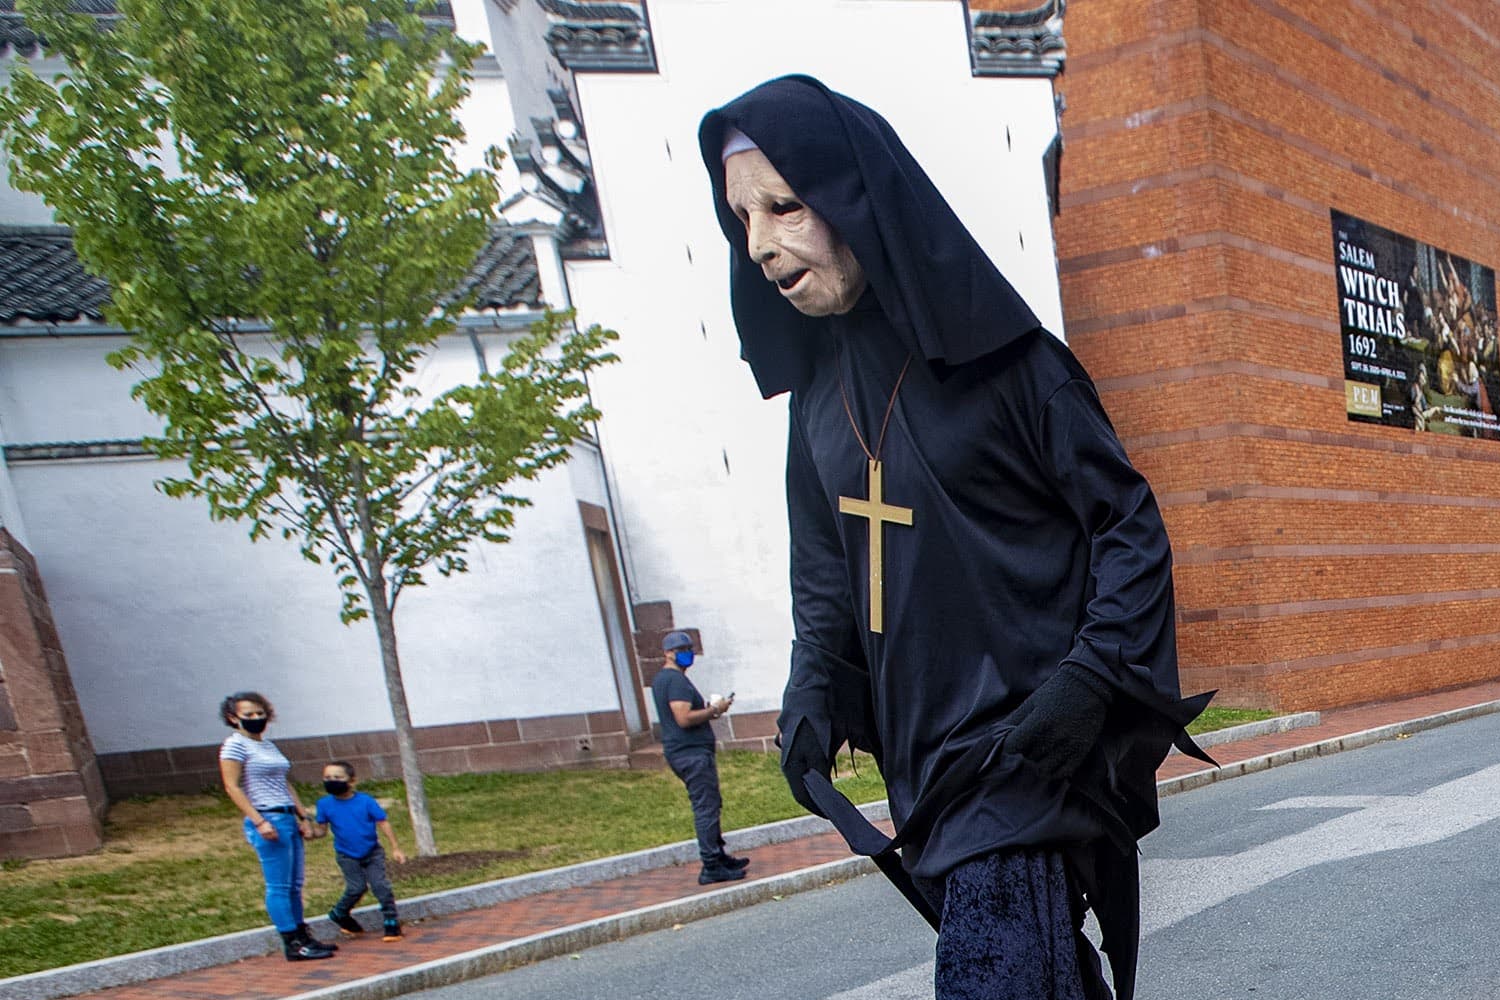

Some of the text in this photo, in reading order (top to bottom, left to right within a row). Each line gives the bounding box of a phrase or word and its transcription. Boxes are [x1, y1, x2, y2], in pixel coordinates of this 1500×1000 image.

[1339, 241, 1376, 270] SALEM
[1339, 265, 1400, 309] WITCH
[1343, 297, 1406, 340] TRIALS
[1349, 333, 1378, 359] 1692
[1353, 386, 1378, 405] PEM
